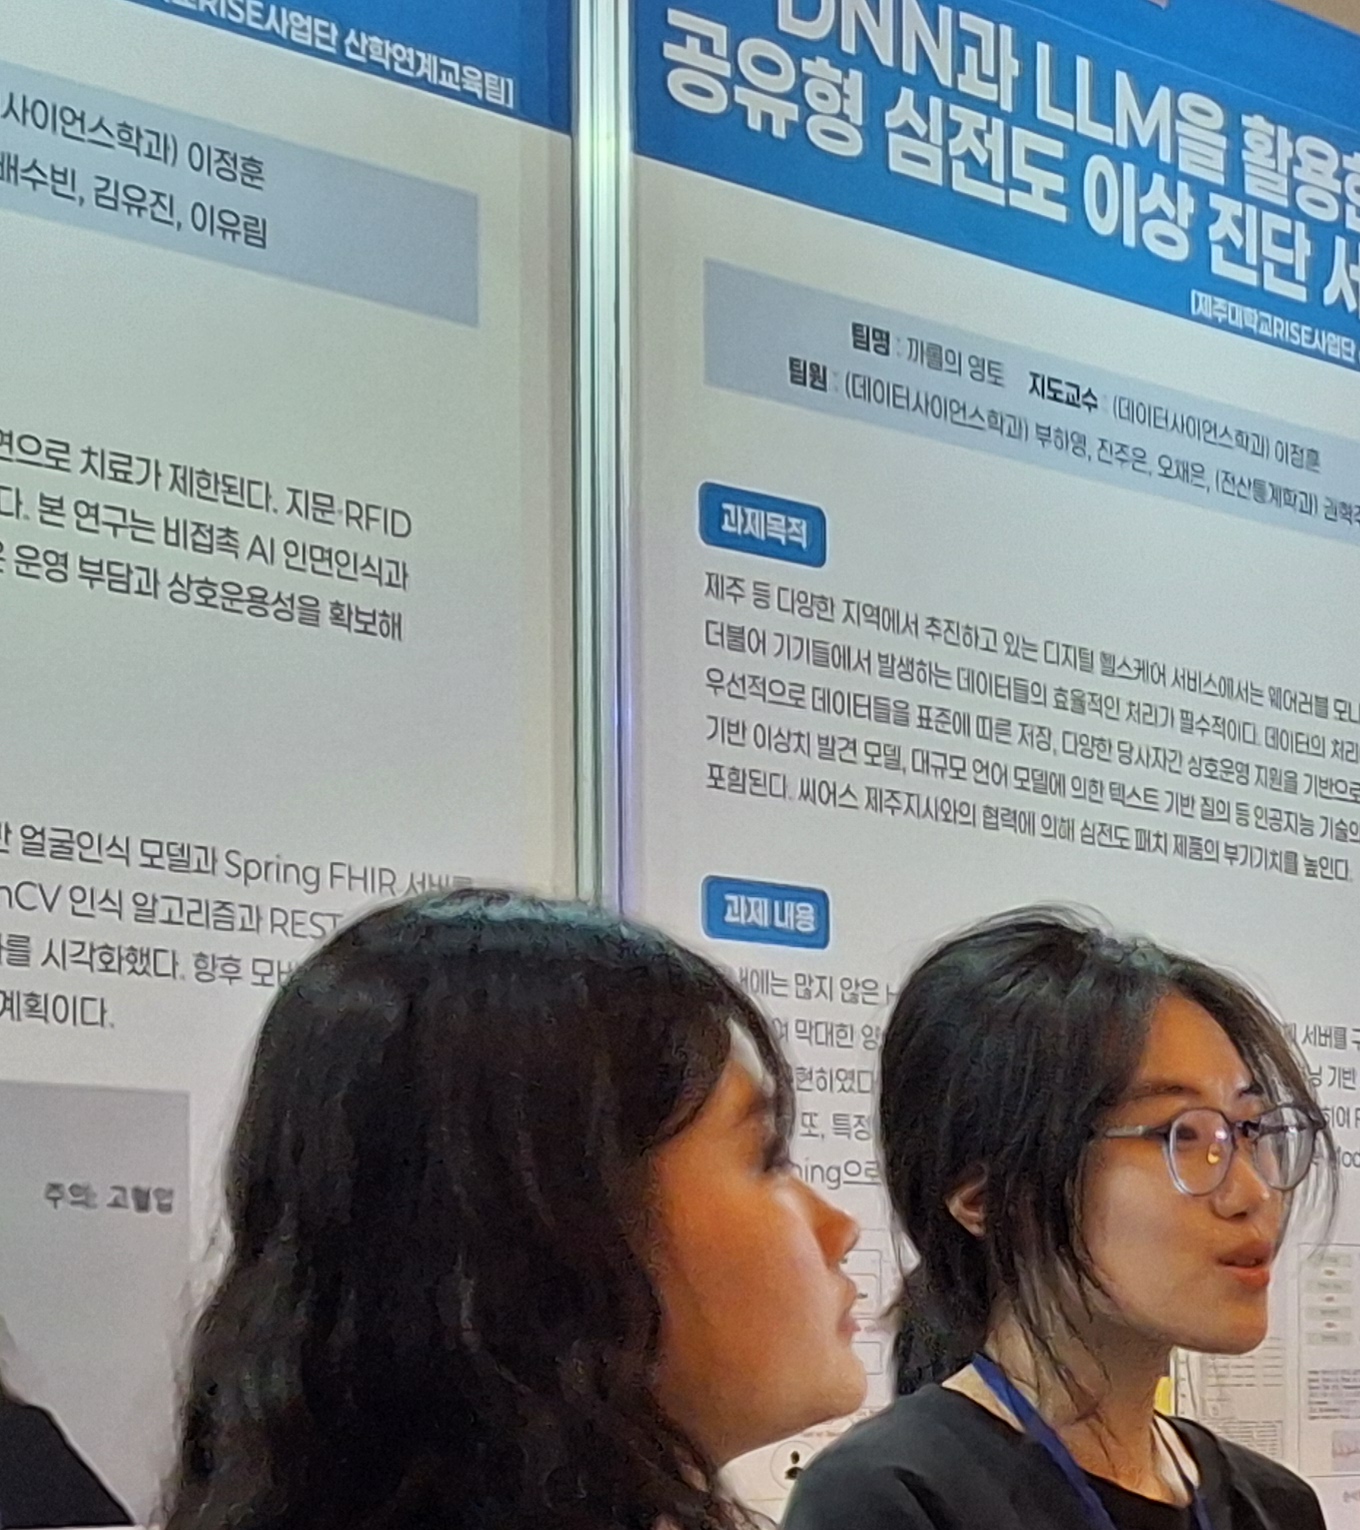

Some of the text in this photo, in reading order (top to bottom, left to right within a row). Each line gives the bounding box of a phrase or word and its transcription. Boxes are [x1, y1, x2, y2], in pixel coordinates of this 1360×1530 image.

[345, 29, 513, 108] 산학연계교육팀]
[1037, 35, 1226, 184] LLM을
[189, 142, 264, 191] 이정훈
[664, 8, 862, 157] 공유형
[885, 86, 1066, 223] 심전도
[1084, 154, 1193, 262] 이상
[1209, 192, 1310, 303] 진단
[95, 175, 180, 228] 김유진,
[191, 201, 266, 250] 이유림
[790, 356, 827, 392] 팀원
[846, 371, 1028, 441] (데이터사이언스학과)
[852, 322, 890, 357] 팀명
[969, 354, 1004, 387] 영토
[1029, 371, 1097, 412] 지도교수
[1113, 396, 1269, 460] (데이터사이언스학과)
[80, 446, 277, 513] 치료가 제한된다.
[39, 492, 408, 591] 본 연구는 비접촉 AI 인면인식과
[722, 503, 807, 549] 과제목적
[15, 544, 401, 641] 운영 부담과 상호운용성을 확보해
[705, 572, 745, 603] 제주
[753, 581, 770, 610] 등
[778, 586, 834, 623] 다양한
[842, 599, 918, 638] 지역에서
[925, 616, 997, 653] 추진하고
[1004, 631, 1038, 663] 있는
[1044, 640, 1093, 674] 디지털
[1100, 651, 1166, 687] 헬스케어
[1171, 667, 1263, 707] 서비스에서는
[706, 619, 765, 656] 더불어
[774, 632, 871, 676] 기기들에서
[878, 651, 951, 690] 발생하는
[957, 666, 1046, 708] 데이터들의
[1053, 686, 1119, 721] 효율적인
[1126, 700, 1174, 728] 처리가
[1180, 709, 1261, 746] 필수적이다.
[1265, 726, 1325, 758] 데이터의
[706, 667, 806, 710] 우선적으로
[812, 686, 909, 727] 데이터들을
[917, 704, 970, 738] 표준에
[976, 714, 1011, 745] 따른
[1018, 722, 1056, 755] 저장,
[1062, 730, 1111, 763] 다양한
[1118, 740, 1182, 775] 당사자간
[1188, 756, 1249, 786] 상호운영
[1255, 764, 1297, 796] 지원을
[707, 715, 747, 747] 기반
[754, 723, 810, 758] 이상치
[818, 733, 857, 765] 발견
[864, 740, 906, 774] 모델,
[912, 748, 966, 781] 대규모
[973, 758, 1007, 787] 언어
[1014, 765, 1065, 798] 모델에
[1071, 775, 1104, 805] 의한
[1109, 781, 1159, 812] 텍스트
[1165, 790, 1195, 819] 기반
[1201, 796, 1230, 824] 질의
[1236, 801, 1249, 828] 등
[1254, 805, 1314, 837] 인공지능
[707, 763, 792, 799] 포함된다.
[799, 778, 858, 810] 씨어스
[865, 786, 976, 828] 제주지사와의
[983, 804, 1035, 837] 협력에
[1041, 814, 1074, 842] 의해
[1081, 820, 1129, 850] 심전도
[1135, 828, 1167, 856] 패치
[1173, 833, 1219, 864] 제품의
[21, 824, 129, 867] 얼굴인식
[140, 839, 216, 876] 모델과
[225, 849, 320, 894] Spring
[330, 861, 394, 896] FHIR
[69, 885, 122, 921] 인식
[132, 892, 261, 934] 알고리즘과
[725, 894, 815, 932] 과제 내용
[41, 939, 241, 986] 시각화했다. 향후
[795, 972, 879, 1006] 많지 않은
[1302, 1024, 1347, 1050] 서버를
[1328, 1065, 1356, 1090] 기반
[800, 1112, 824, 1140] 또,
